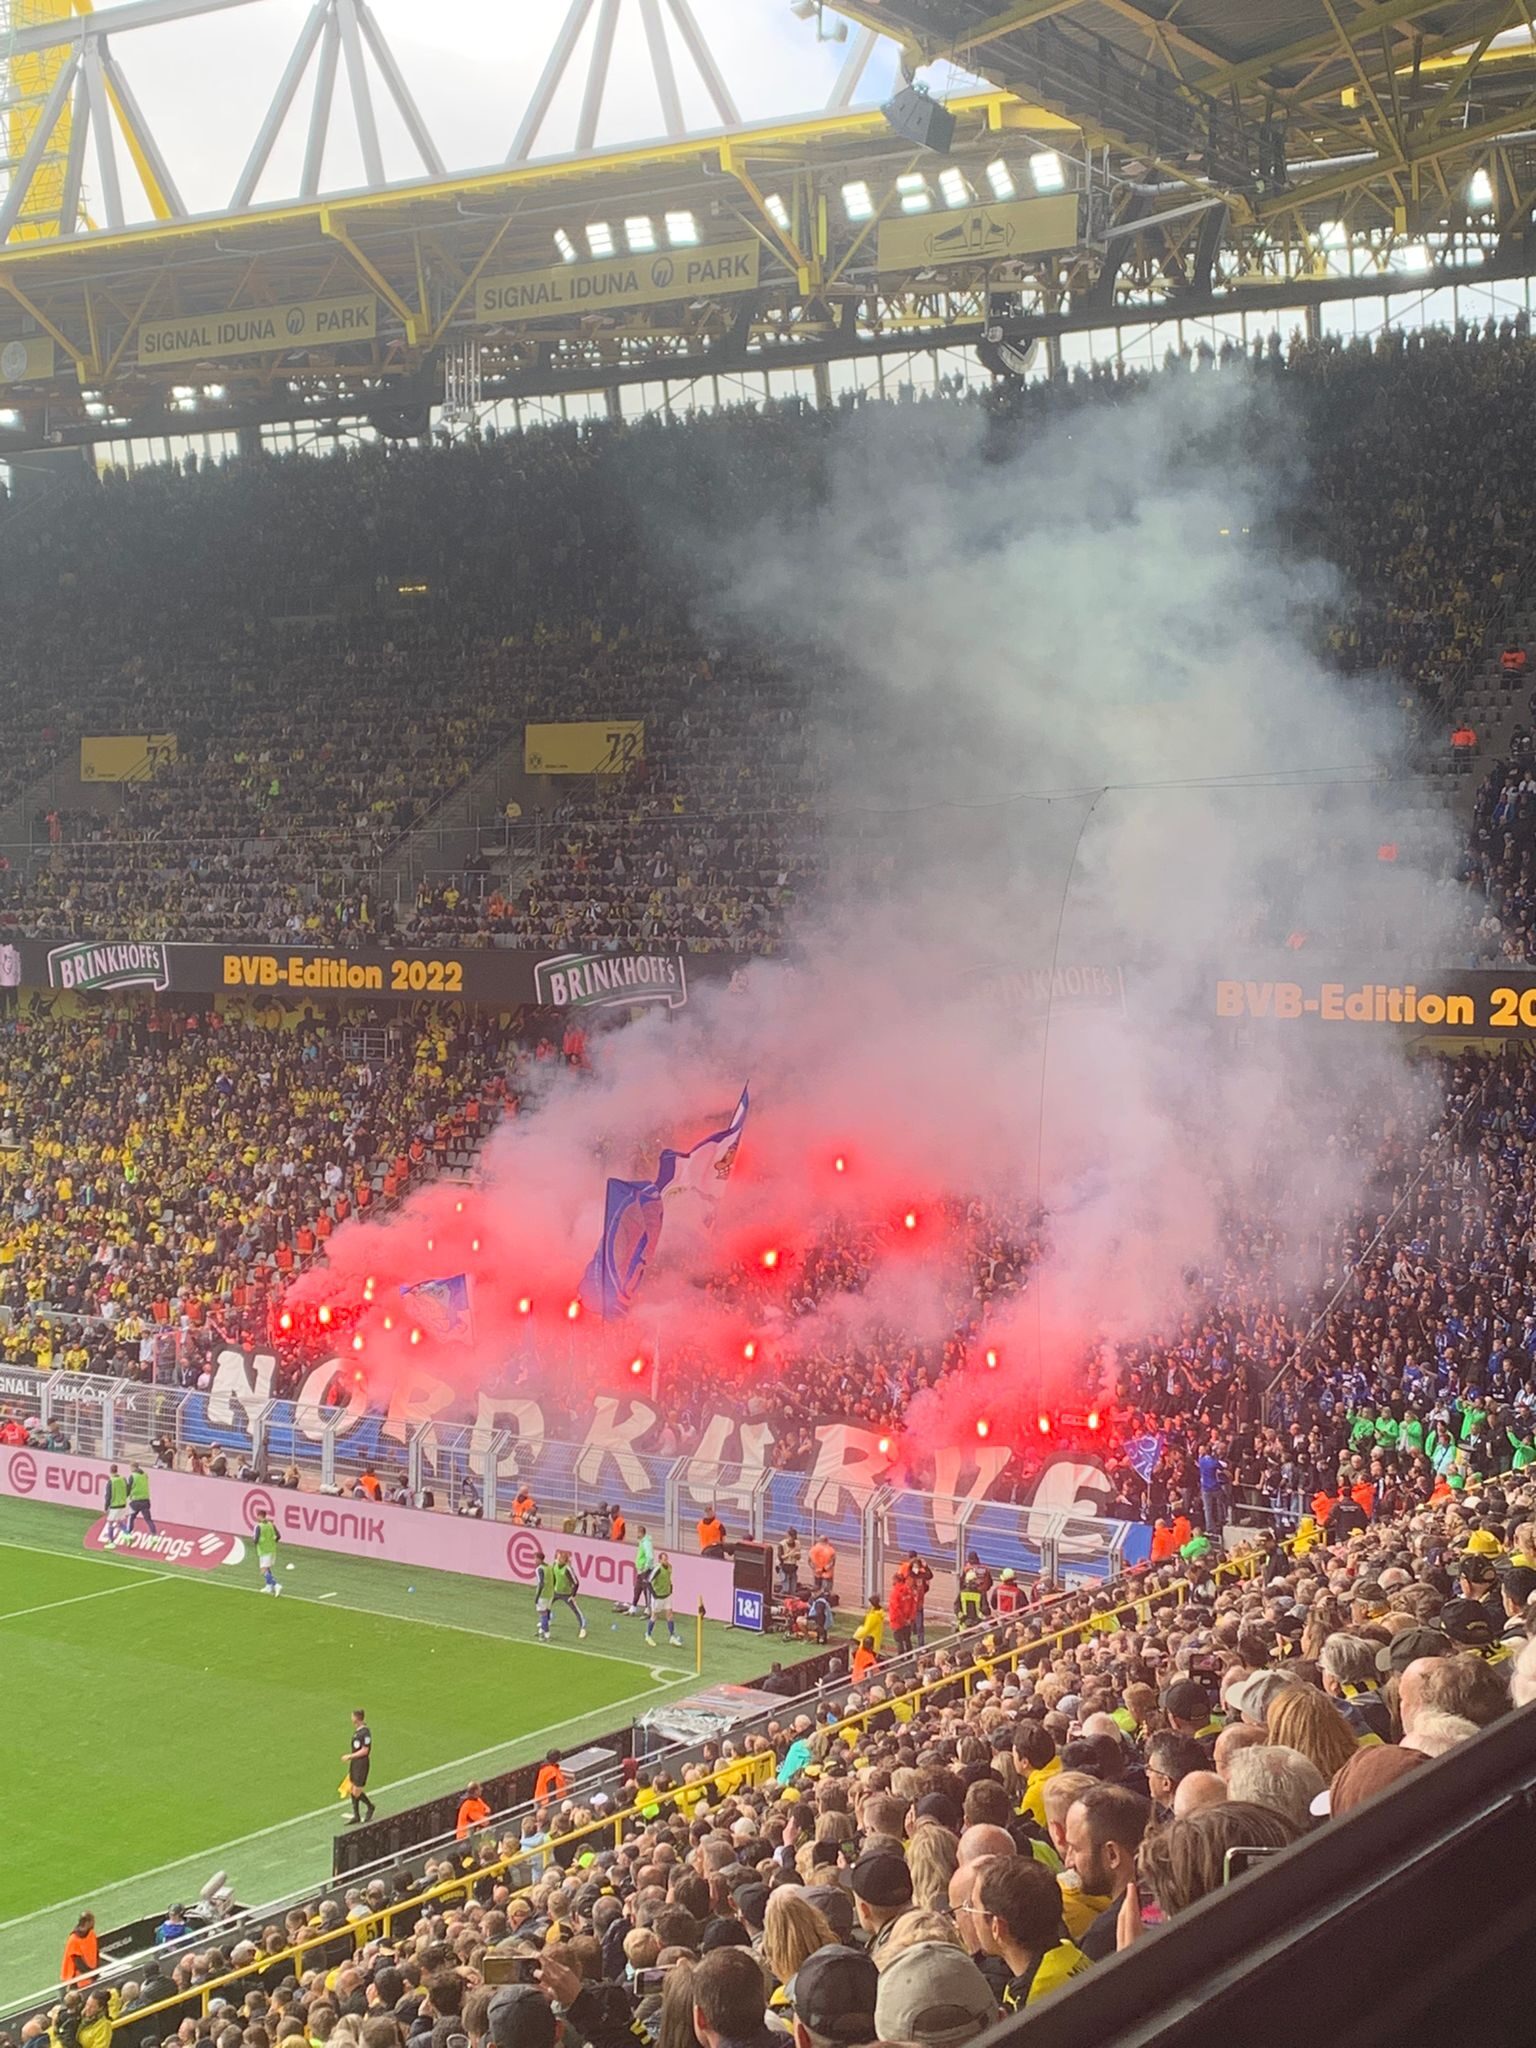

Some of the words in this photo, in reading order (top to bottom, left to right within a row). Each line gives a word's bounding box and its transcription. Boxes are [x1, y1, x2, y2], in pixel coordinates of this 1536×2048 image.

[484, 281, 562, 311] SIGNAL
[570, 271, 639, 300] IDUNA
[687, 254, 750, 284] PARK
[145, 327, 211, 353] SIGNAL
[217, 320, 276, 345] IDUNA
[316, 306, 370, 332] PARK
[606, 732, 637, 763] 72
[223, 955, 383, 990] BVB-Edition
[391, 959, 463, 992] 2022
[1215, 980, 1475, 1025] BVB-Edition
[45, 1466, 109, 1496] EVON
[284, 1505, 385, 1544] EVONIK
[737, 1597, 760, 1618] 1&1
